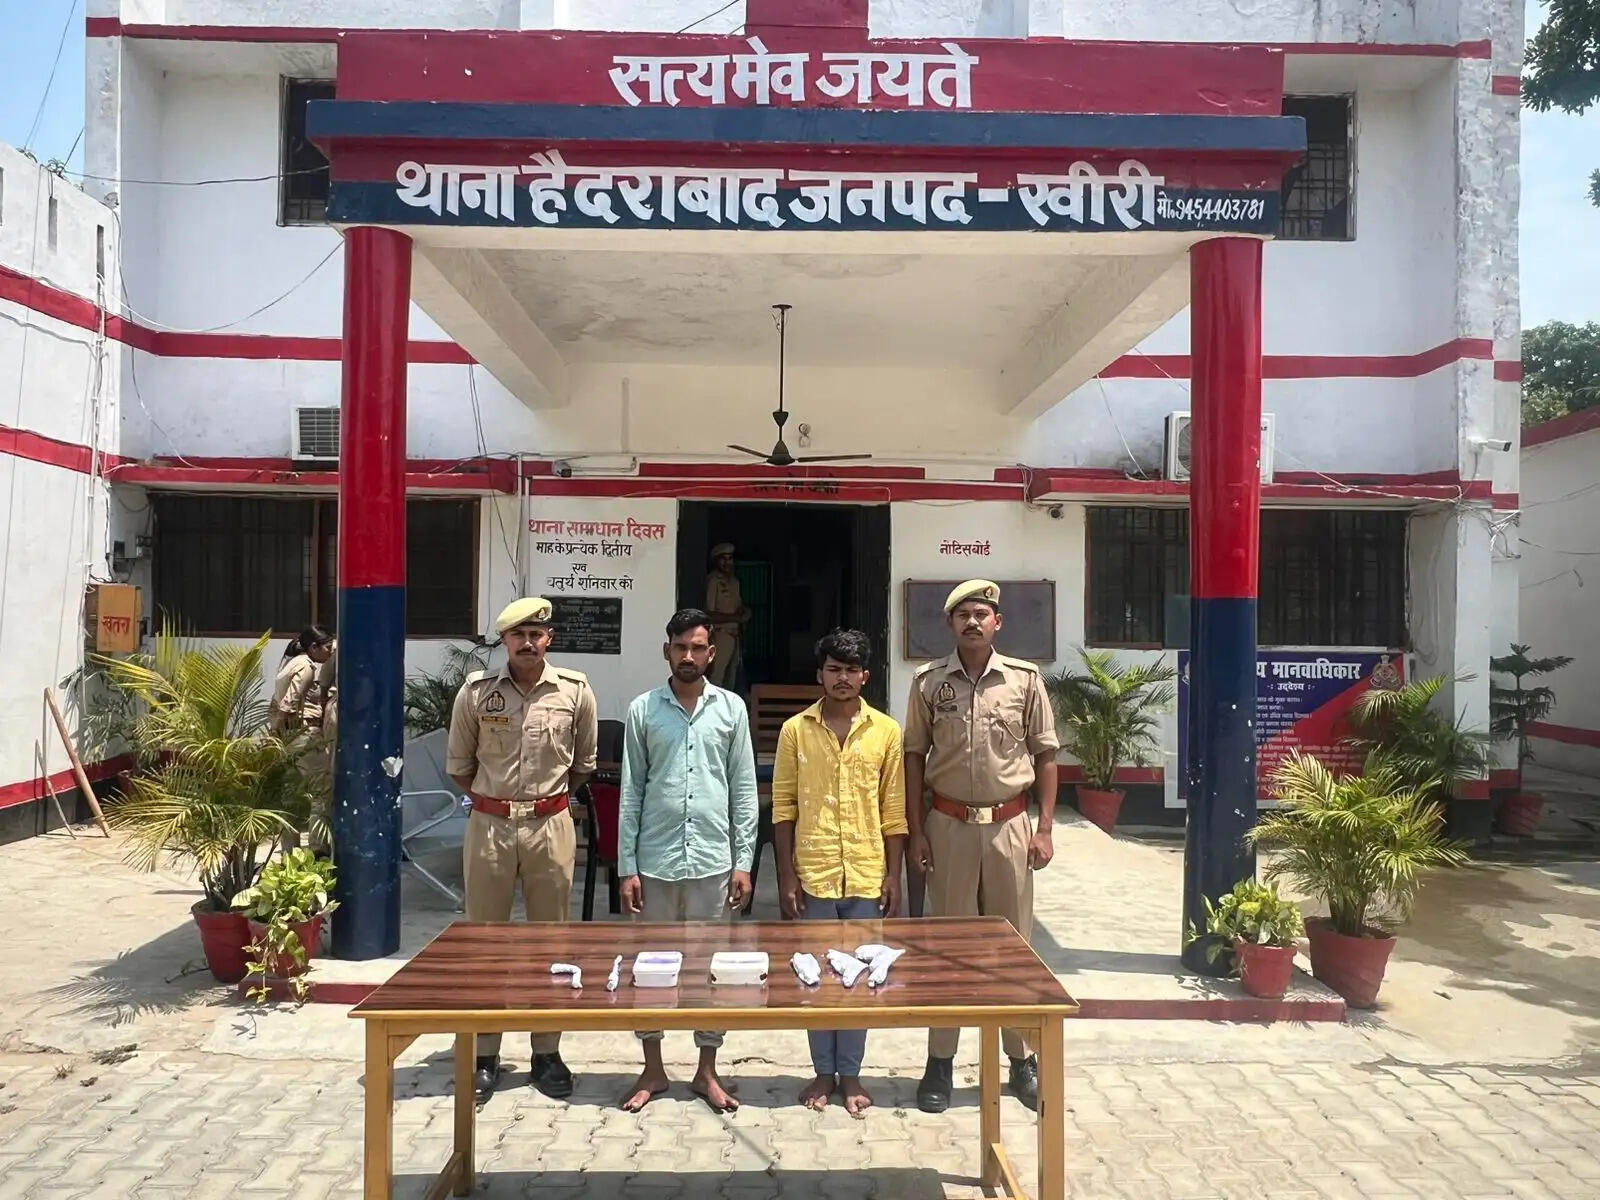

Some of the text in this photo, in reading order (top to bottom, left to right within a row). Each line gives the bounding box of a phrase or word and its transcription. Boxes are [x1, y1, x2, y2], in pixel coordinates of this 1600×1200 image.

[815, 42, 980, 108] जयते
[395, 160, 518, 220] थाना
[517, 148, 787, 227] हैदराबाद
[1017, 159, 1165, 230] खीरी
[529, 519, 565, 535] थाना
[626, 517, 666, 541] दिवस
[577, 574, 617, 591] शनिवार
[619, 575, 634, 590] को
[1270, 657, 1362, 680] मानवाधिकार
